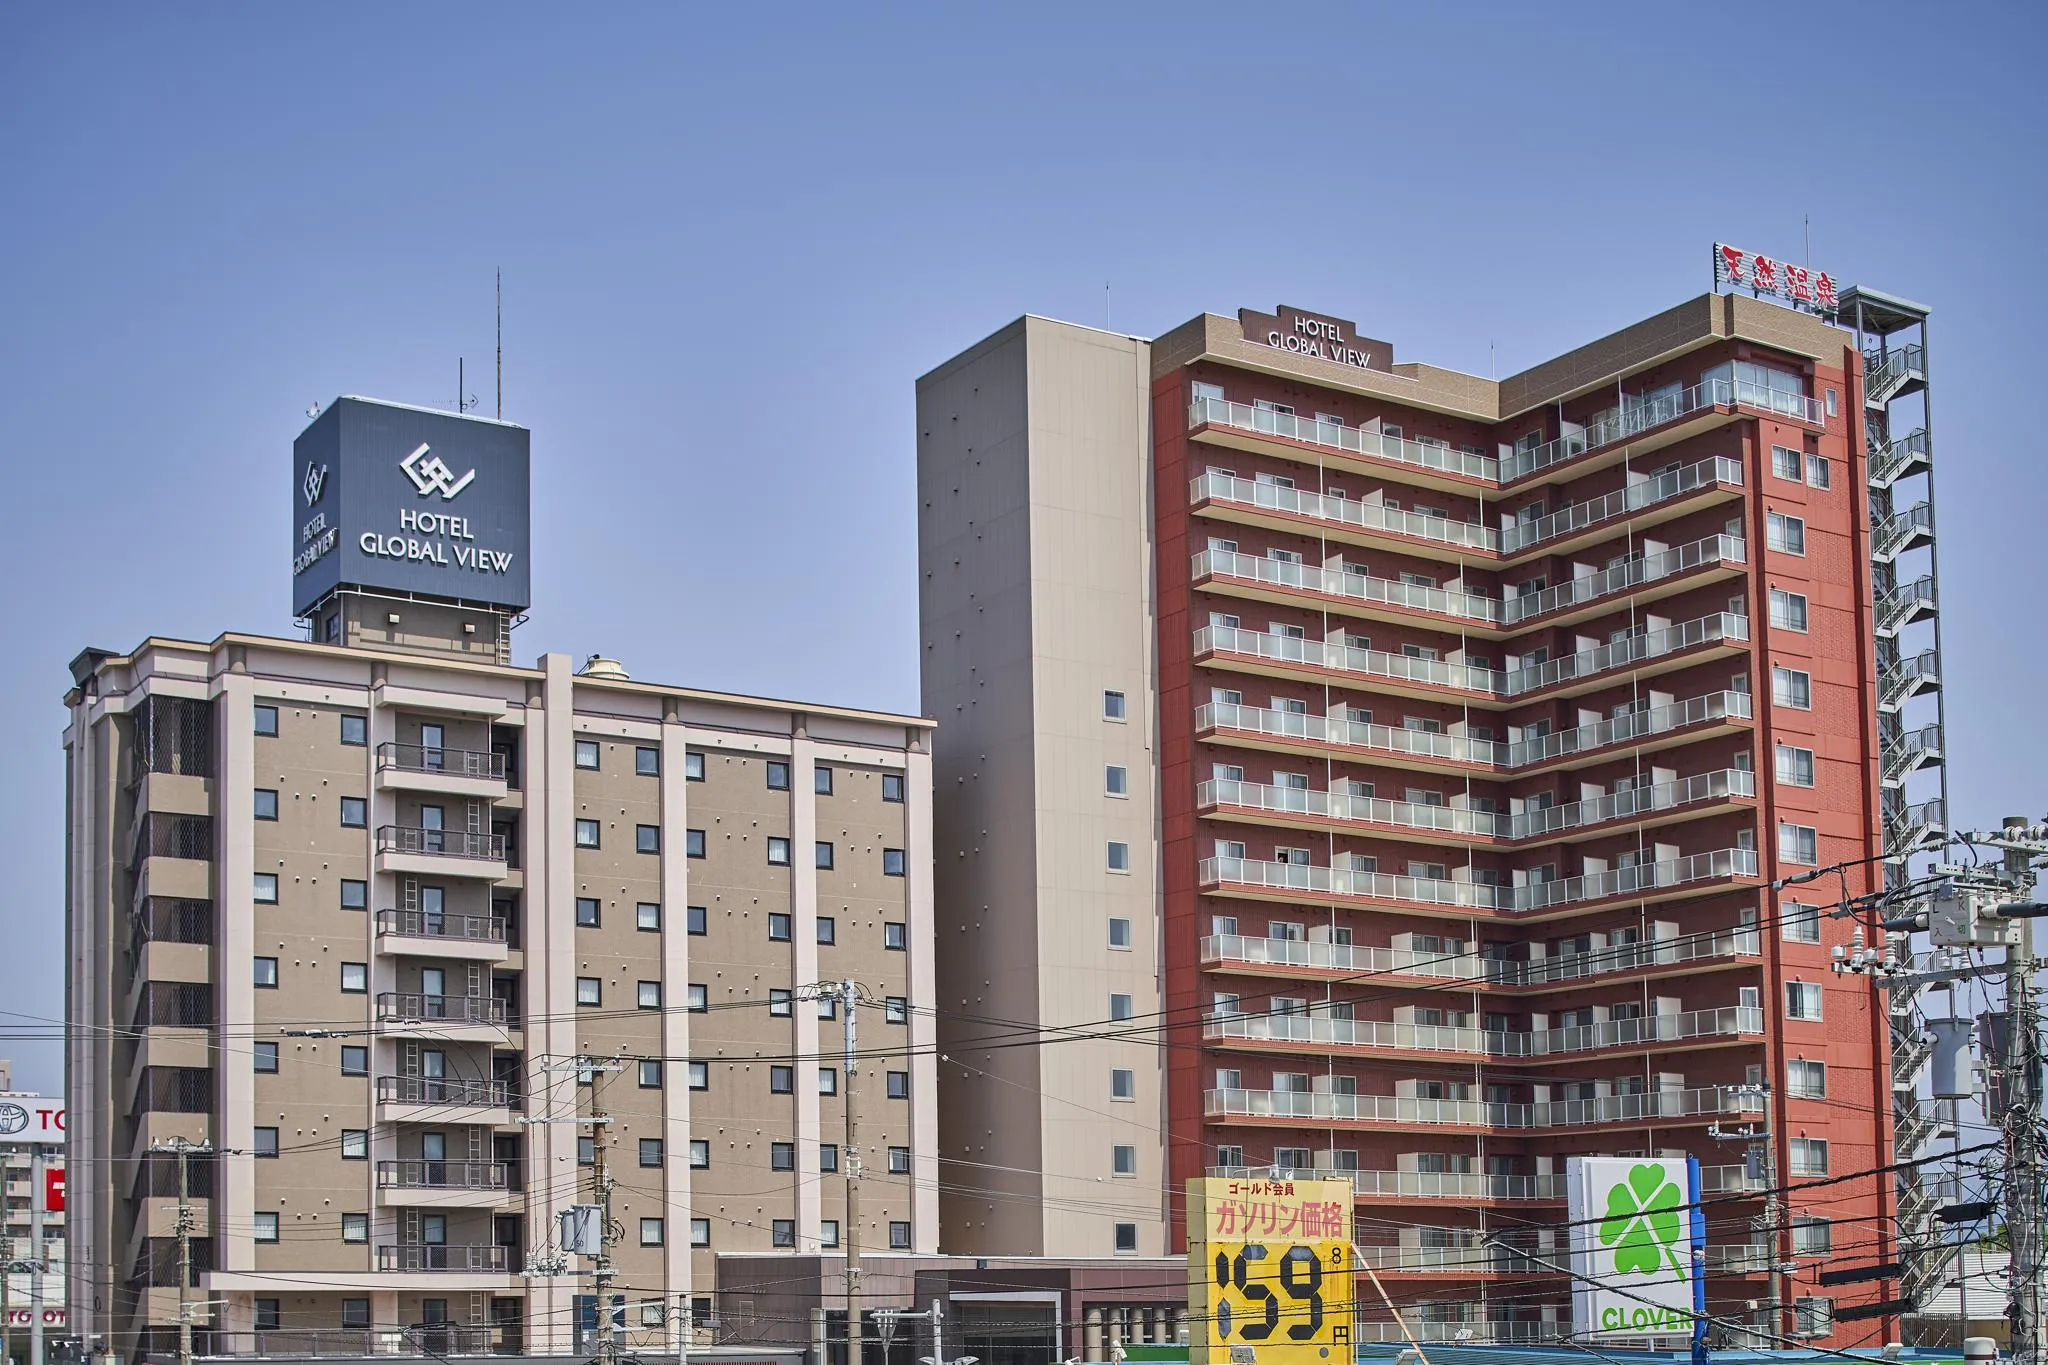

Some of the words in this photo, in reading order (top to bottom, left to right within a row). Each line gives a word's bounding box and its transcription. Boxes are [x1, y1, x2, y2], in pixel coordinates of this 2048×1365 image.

[1721, 244, 1840, 308] 天然温泉
[1294, 316, 1345, 343] HOTEL
[1268, 331, 1328, 360] GLOBAL
[1330, 345, 1371, 369] VIEW
[303, 512, 327, 544] HOTEL
[400, 509, 474, 540] HOTEL
[317, 527, 339, 556] VIEW
[360, 532, 449, 564] GLOBAL
[453, 544, 513, 573] VIEW
[1229, 1182, 1295, 1197] ゴールド会員
[1216, 1200, 1343, 1238] ガソリン価格
[1331, 1247, 1342, 1265] 8
[1215, 1244, 1323, 1341] 159
[1602, 1307, 1693, 1331] CLOVER
[1333, 1326, 1349, 1346] 円
